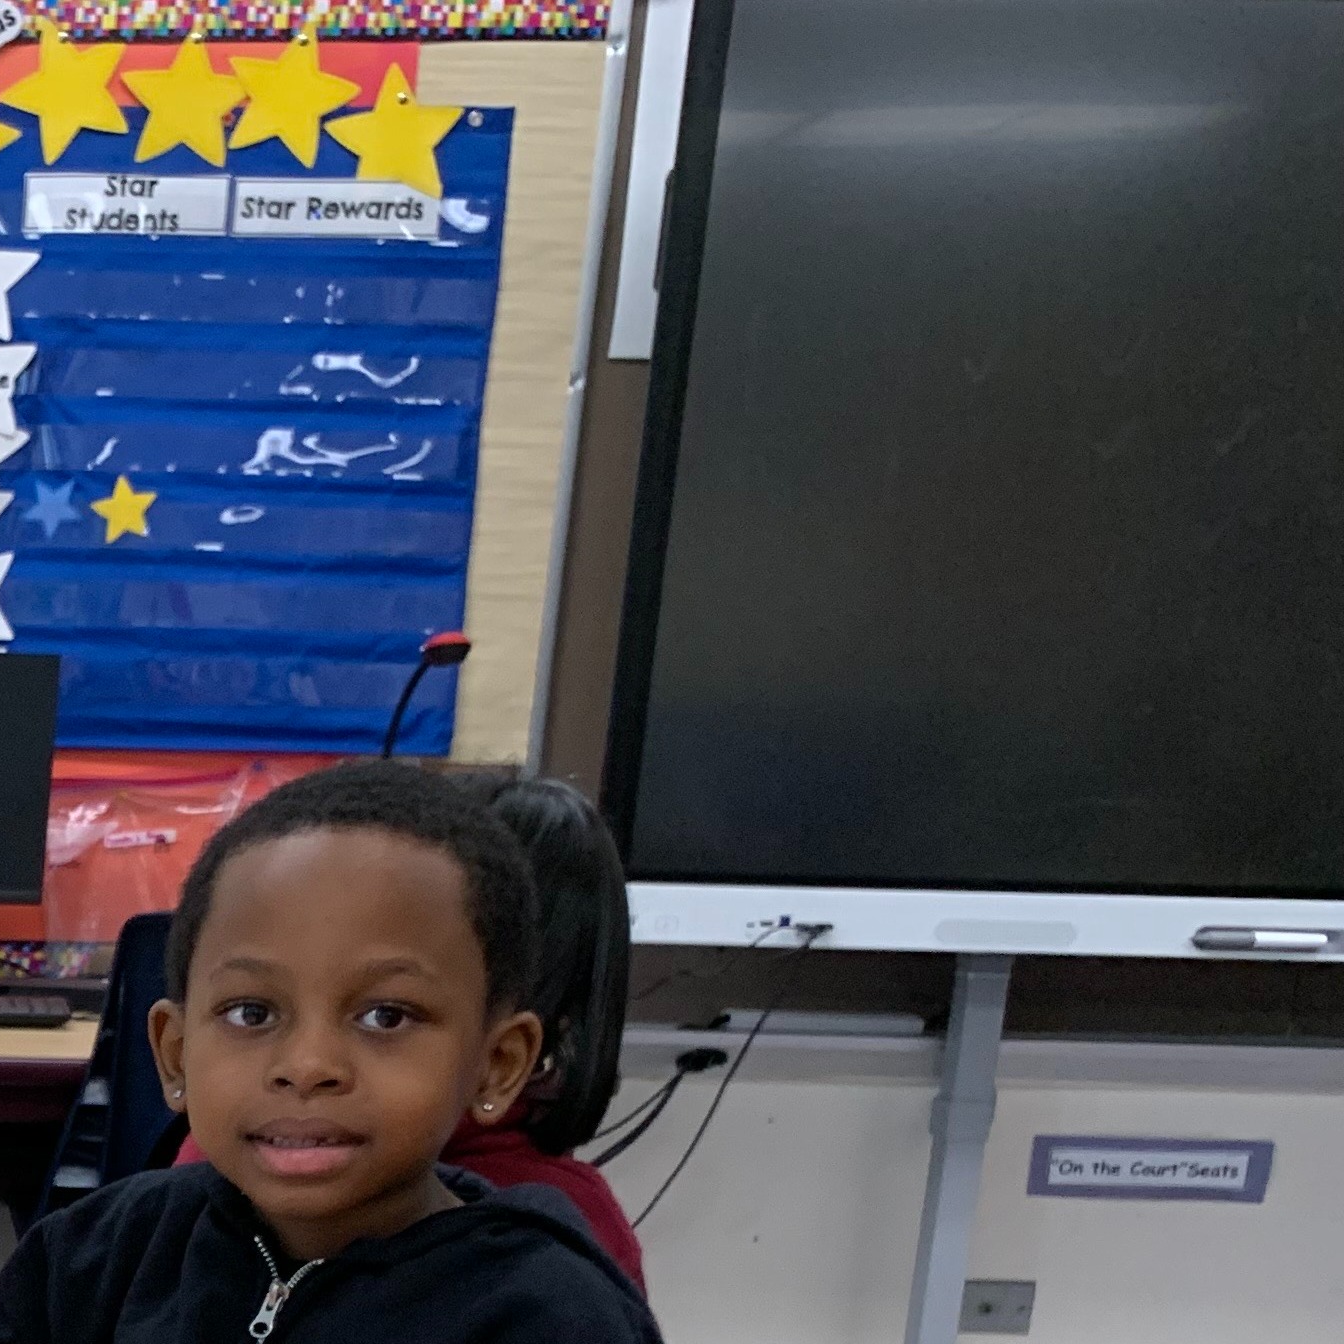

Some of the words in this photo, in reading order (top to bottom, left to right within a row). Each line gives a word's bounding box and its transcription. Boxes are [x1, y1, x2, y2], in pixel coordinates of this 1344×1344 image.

[103, 176, 159, 199] Star
[63, 207, 181, 233] Students
[240, 196, 296, 221] Star
[305, 197, 426, 222] Rewards
[1091, 1159, 1121, 1177] the
